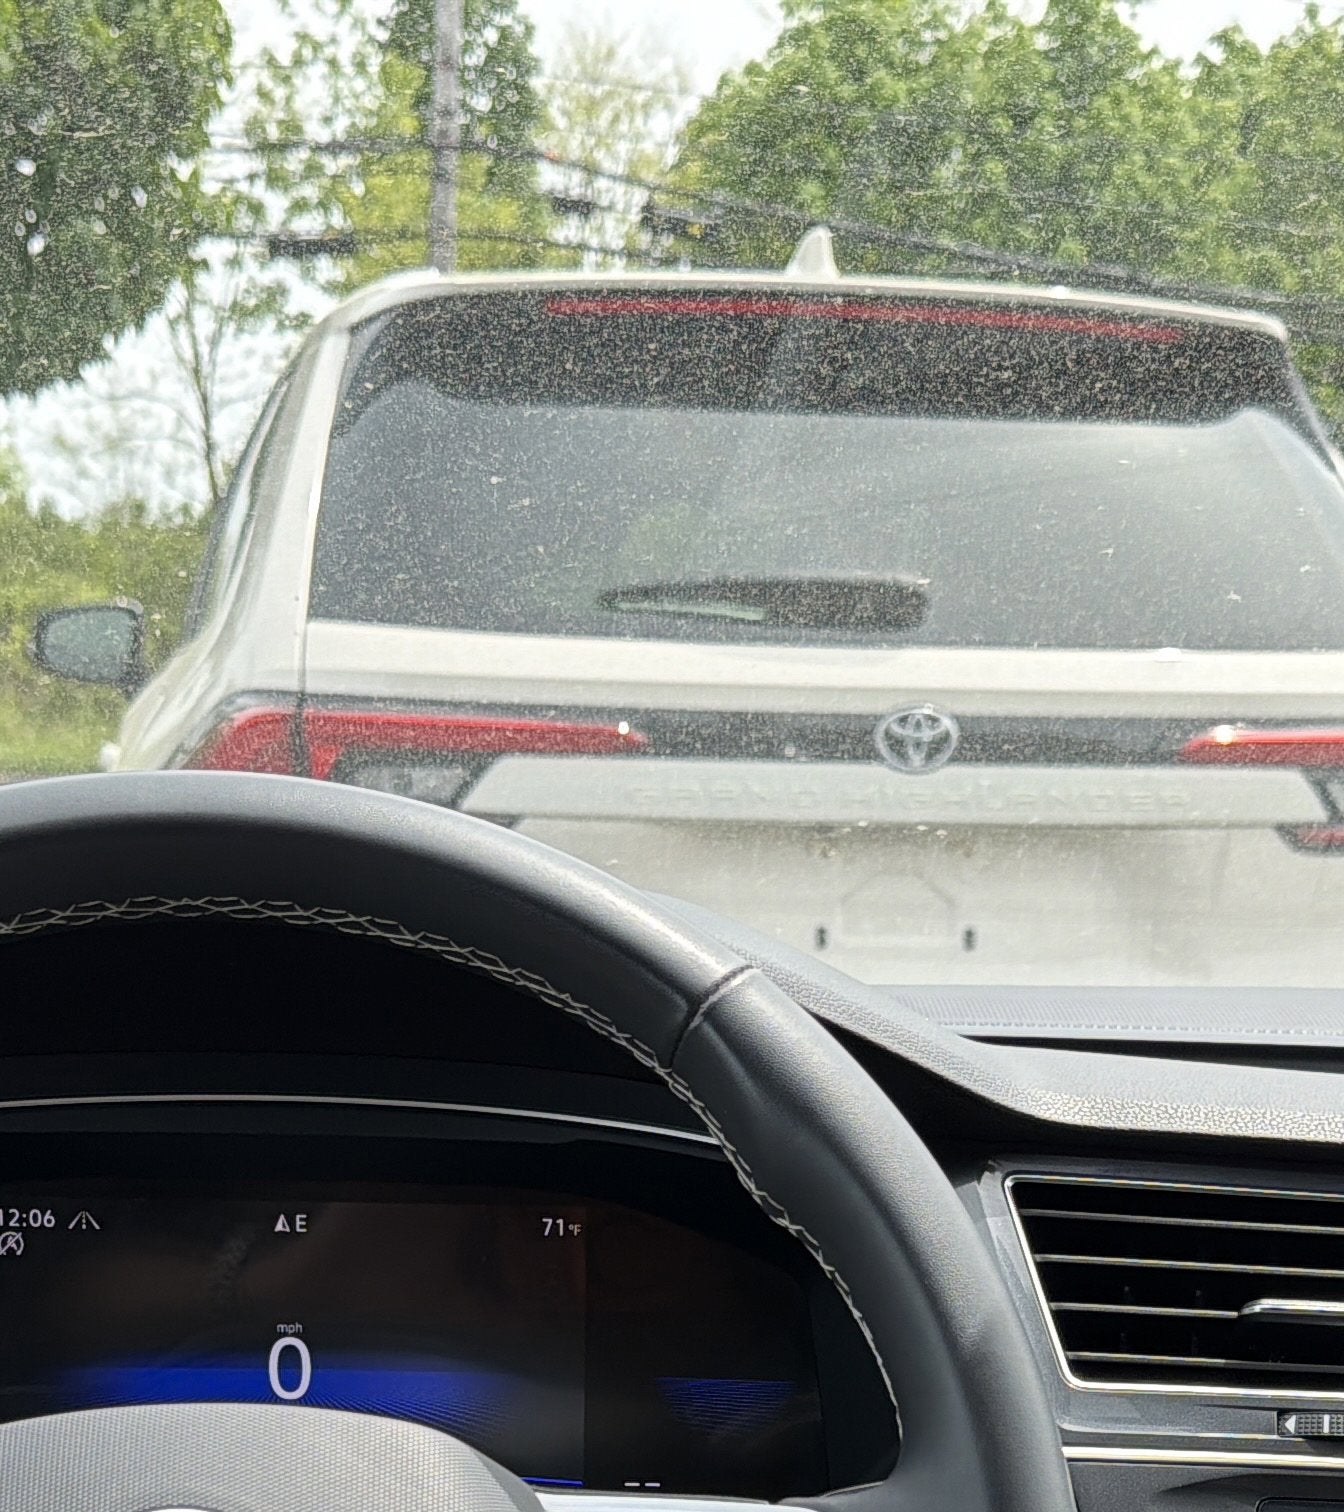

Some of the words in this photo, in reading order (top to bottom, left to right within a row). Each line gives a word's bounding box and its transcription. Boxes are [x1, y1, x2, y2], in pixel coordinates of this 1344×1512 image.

[295, 1214, 308, 1233] E
[276, 1322, 303, 1340] mph
[268, 1336, 312, 1400] 0
